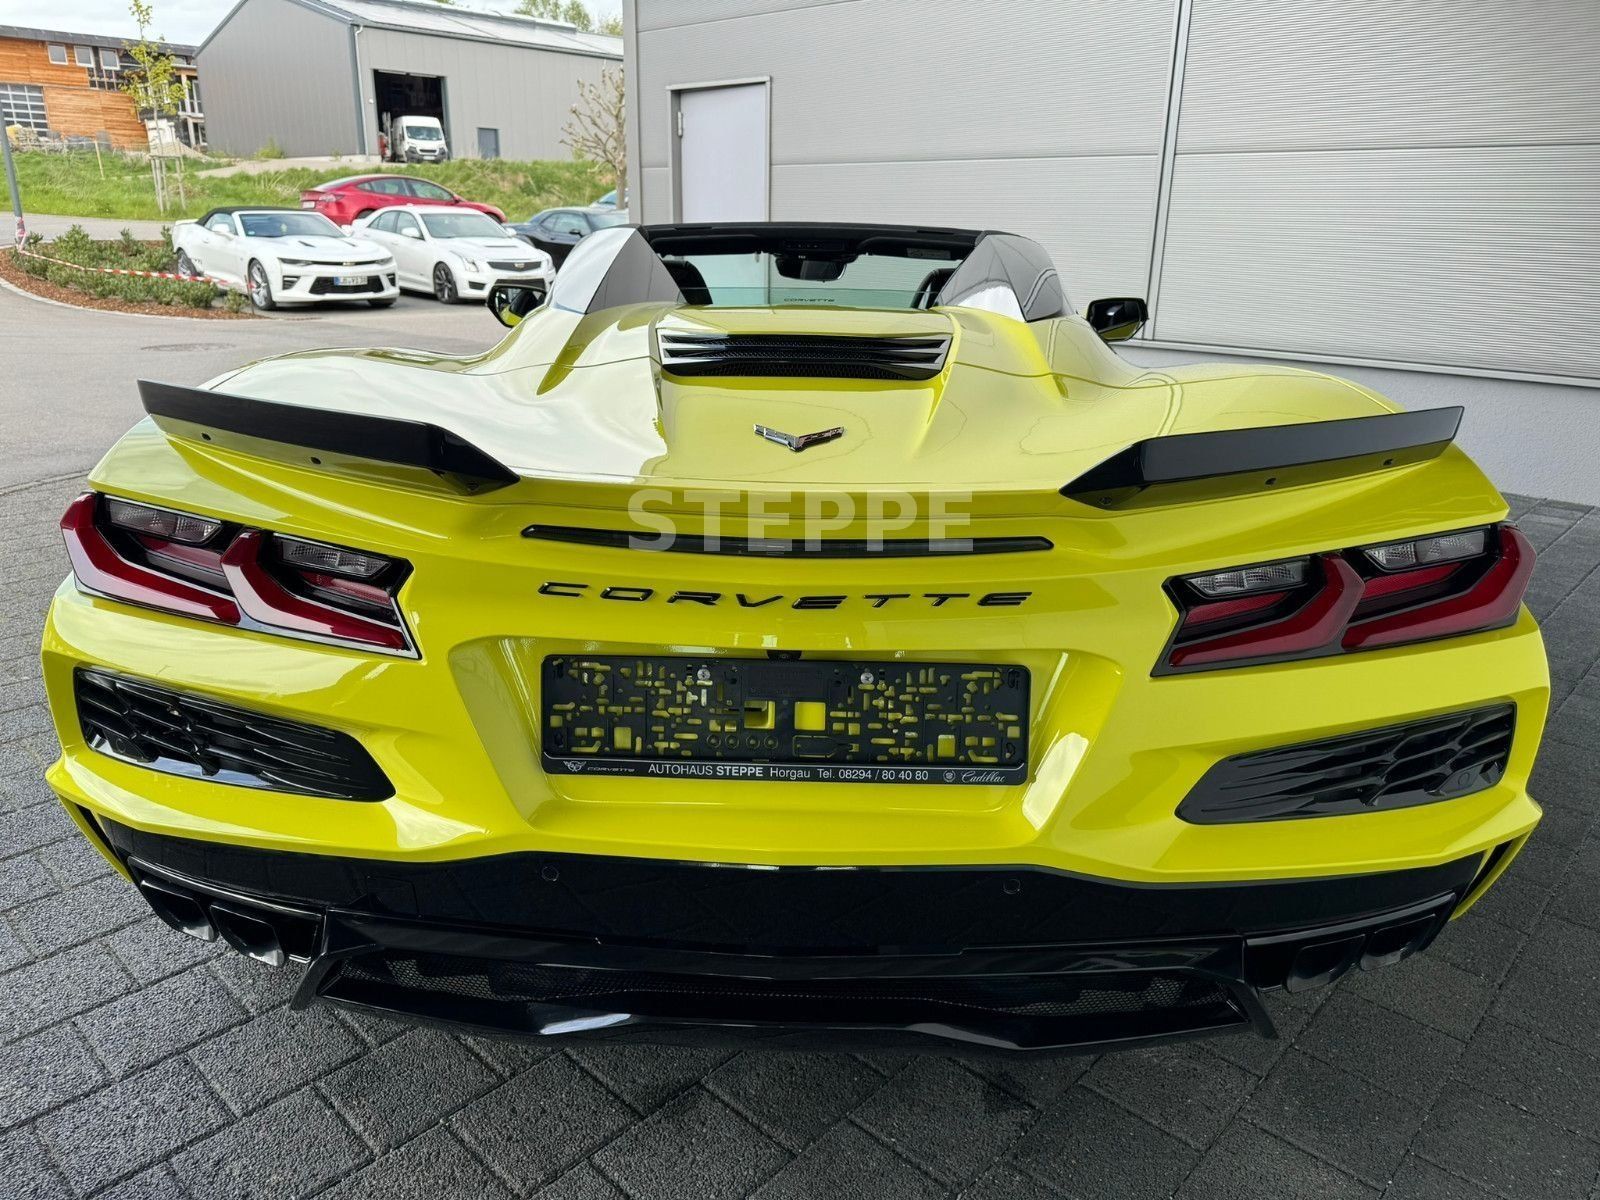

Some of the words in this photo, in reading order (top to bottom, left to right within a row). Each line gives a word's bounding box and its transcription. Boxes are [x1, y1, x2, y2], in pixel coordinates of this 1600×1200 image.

[538, 581, 1032, 610] CORVETTE
[648, 764, 713, 776] AUTOHAUS
[716, 766, 764, 777] STEPPE
[770, 767, 811, 780] Horgau
[817, 768, 835, 779] Tel.
[838, 768, 872, 780] 08294
[881, 769, 897, 781] 80
[898, 769, 912, 781] 40
[915, 769, 929, 781] 80
[961, 770, 1006, 783] Cadillac
